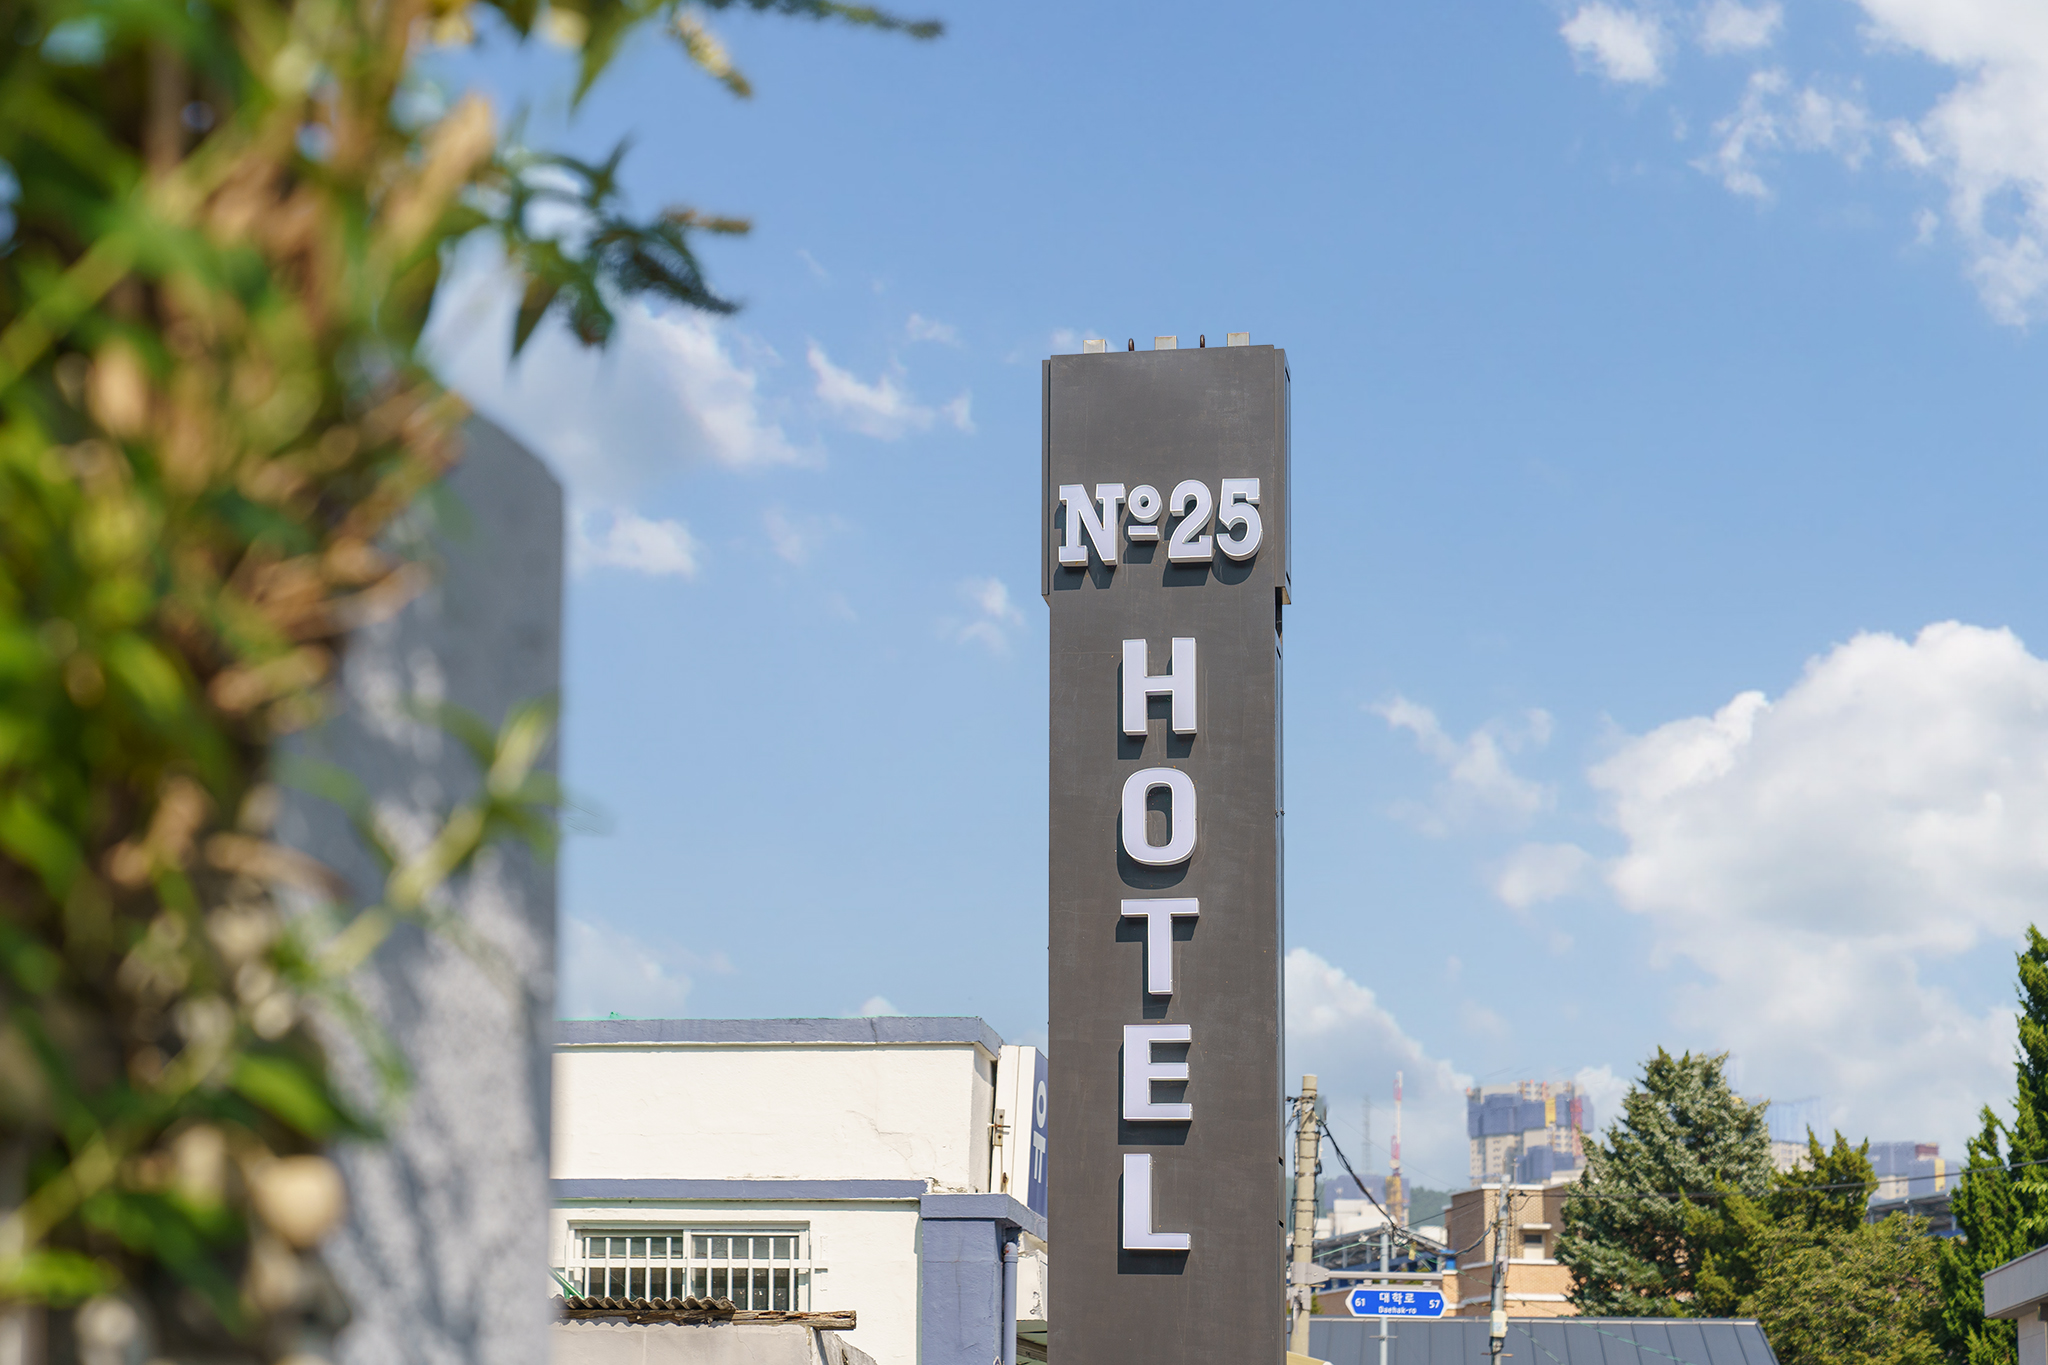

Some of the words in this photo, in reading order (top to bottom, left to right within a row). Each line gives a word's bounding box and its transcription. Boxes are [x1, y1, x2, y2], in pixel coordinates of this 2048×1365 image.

[1121, 636, 1199, 1251] HOTEL
[1354, 1297, 1366, 1307] 61
[1378, 1292, 1415, 1305] 대학로
[1428, 1299, 1441, 1309] 57
[1378, 1305, 1417, 1314] Daehak-ro
